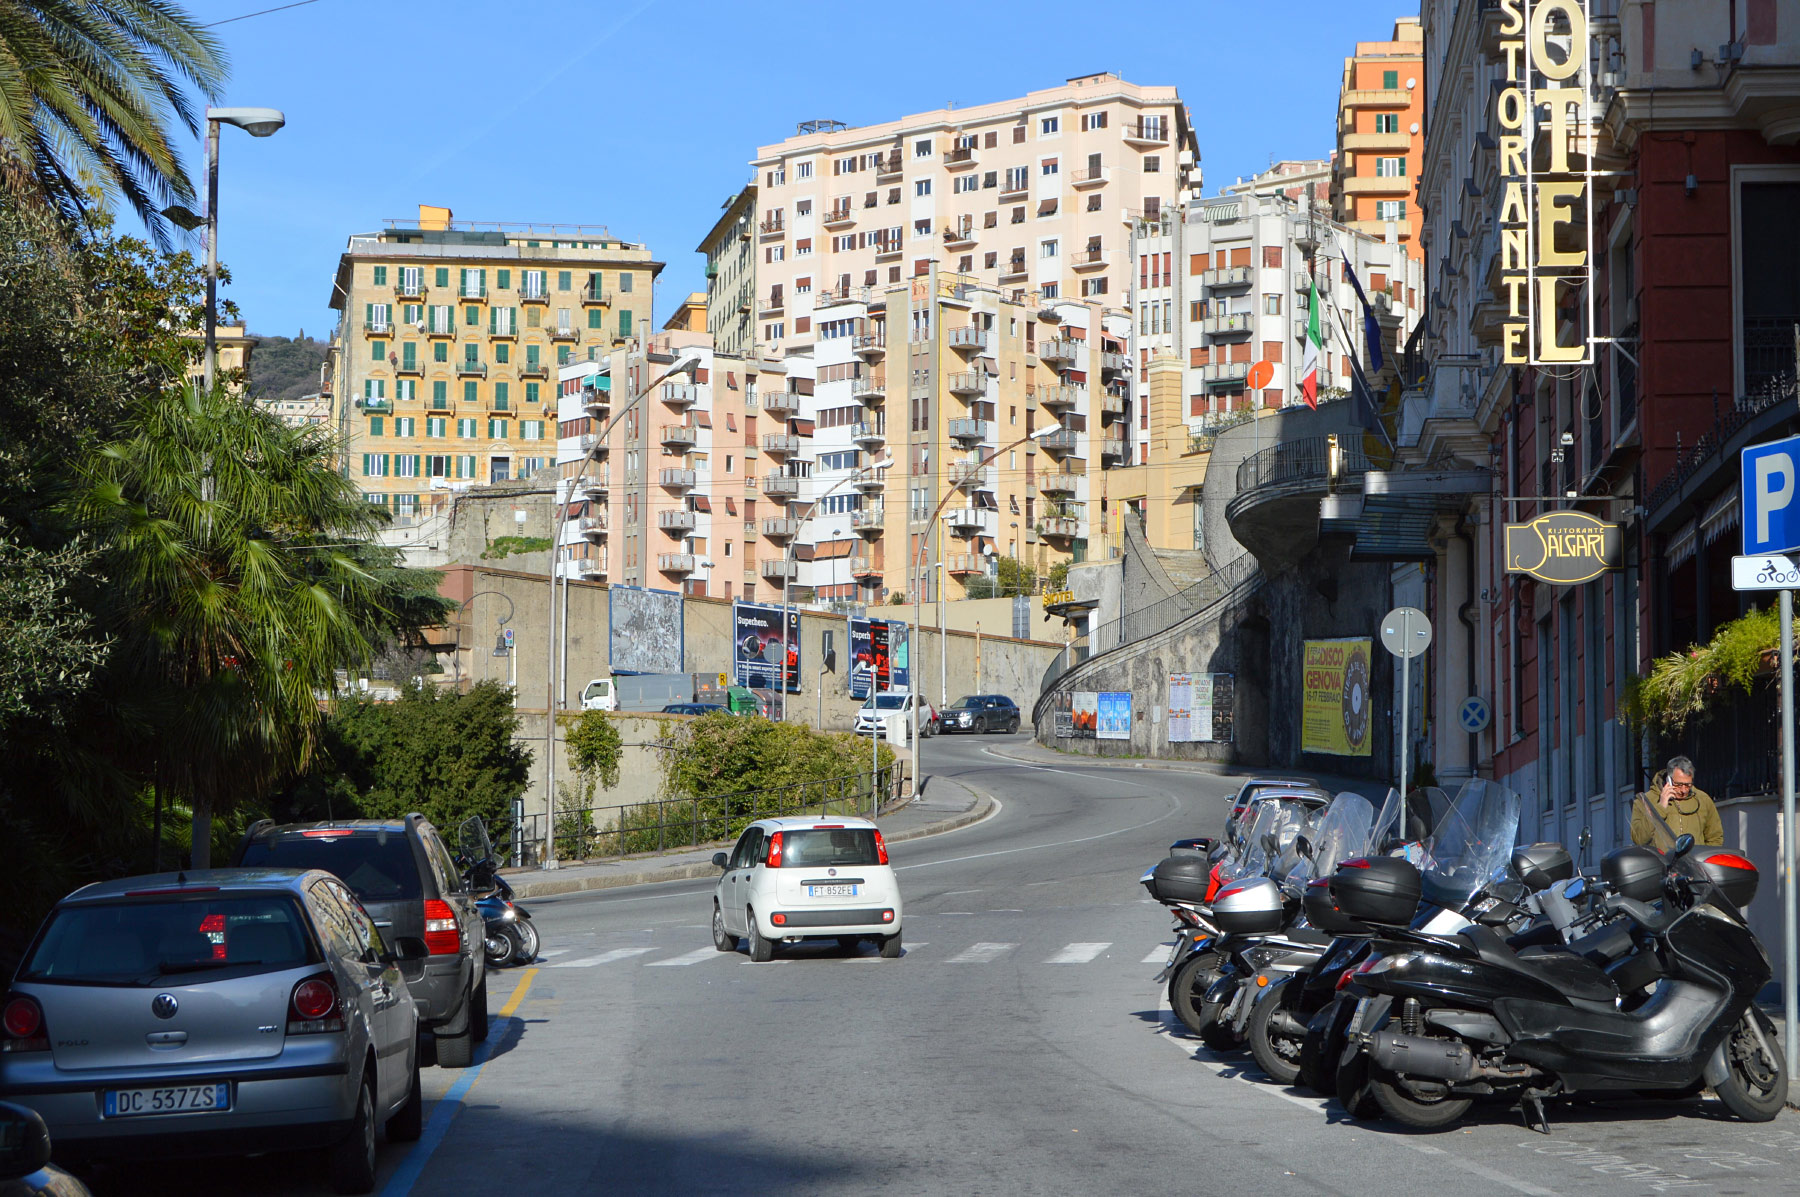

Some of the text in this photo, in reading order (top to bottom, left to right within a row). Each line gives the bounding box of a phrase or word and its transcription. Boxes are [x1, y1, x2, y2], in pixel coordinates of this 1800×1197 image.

[1531, 0, 1587, 362] OTEL
[1755, 452, 1795, 544] P
[1515, 519, 1609, 571] SALGARI
[1320, 648, 1344, 666] DISCO
[720, 674, 726, 684] R
[1306, 671, 1341, 690] GENOVA
[814, 886, 852, 896] FT 852FE
[119, 1092, 142, 1112] DC
[152, 1087, 214, 1109] 537ZS
